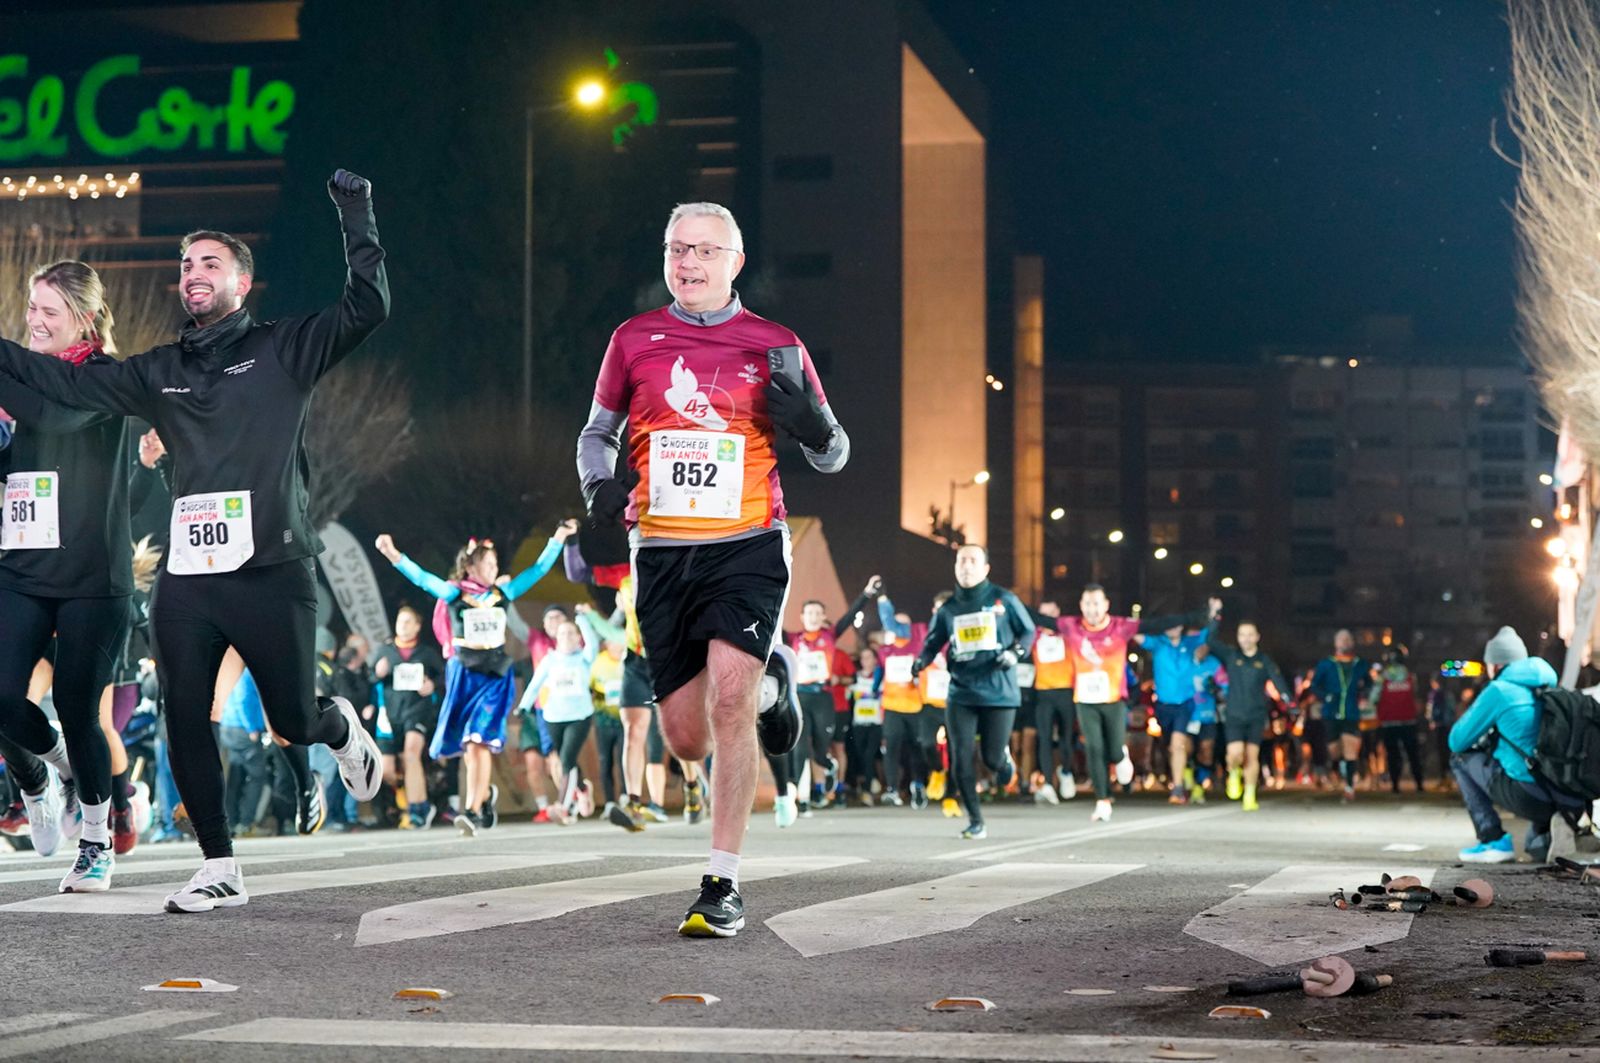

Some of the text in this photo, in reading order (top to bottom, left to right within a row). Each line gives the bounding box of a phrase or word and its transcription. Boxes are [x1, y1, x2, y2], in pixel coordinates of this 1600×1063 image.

[74, 54, 296, 158] Corte
[684, 399, 708, 418] 43
[660, 450, 676, 460] SAN
[669, 439, 709, 450] NOCHE DE
[672, 461, 718, 487] 852
[11, 500, 36, 522] 581
[188, 521, 229, 547] 580
